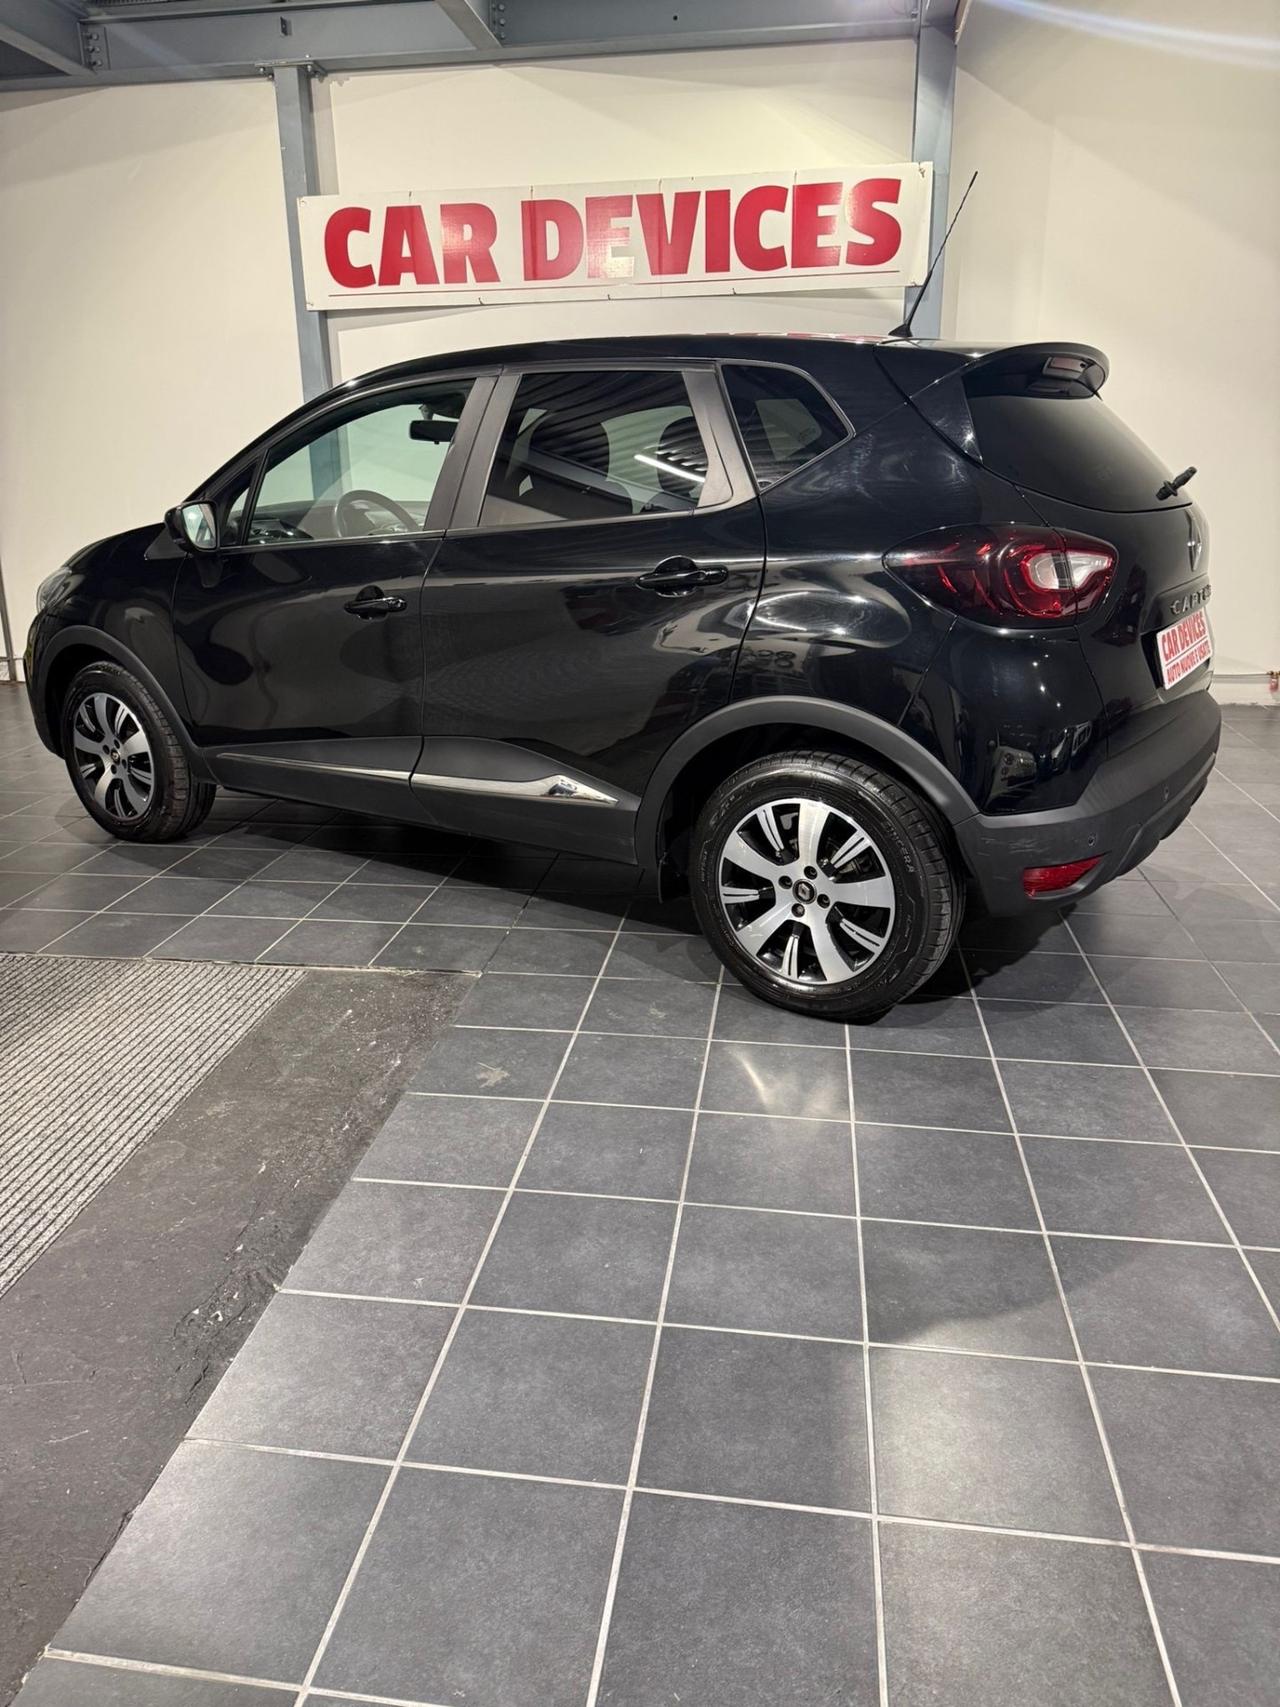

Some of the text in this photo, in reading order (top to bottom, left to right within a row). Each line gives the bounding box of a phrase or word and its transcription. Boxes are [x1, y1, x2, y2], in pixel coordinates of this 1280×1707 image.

[324, 178, 902, 288] CAR DEVICES
[1161, 611, 1206, 661] CAR DEVICES
